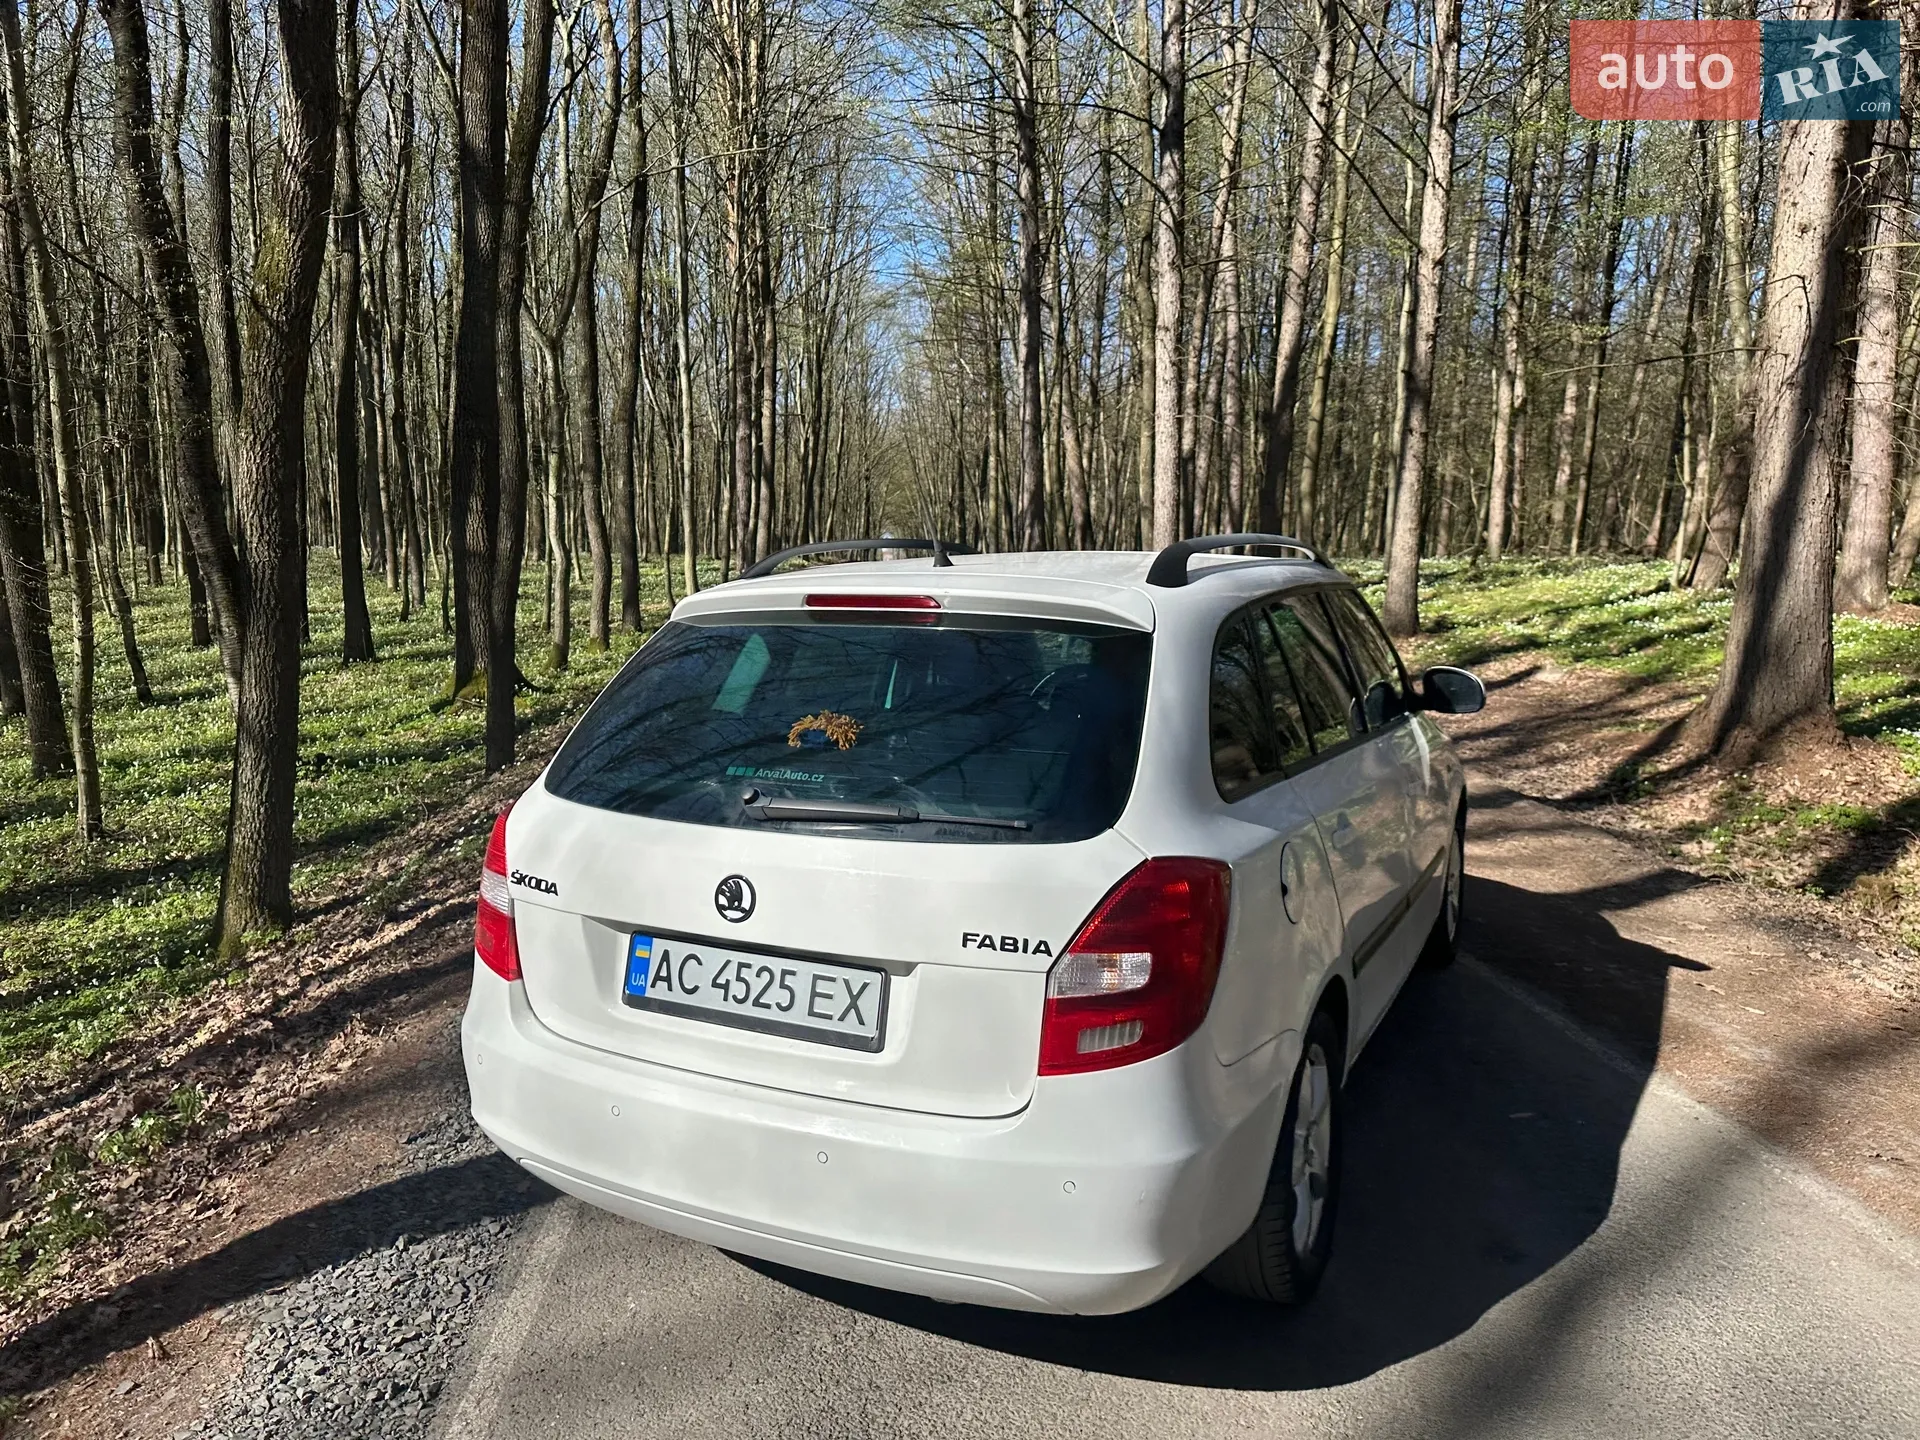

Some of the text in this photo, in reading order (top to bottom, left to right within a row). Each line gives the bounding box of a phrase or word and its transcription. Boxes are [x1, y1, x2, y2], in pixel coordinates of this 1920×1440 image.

[755, 768, 825, 782] ArvalAuto.cz
[962, 932, 1053, 957] FABIA
[631, 972, 646, 987] UA
[650, 949, 871, 1026] AC 4525 EX
